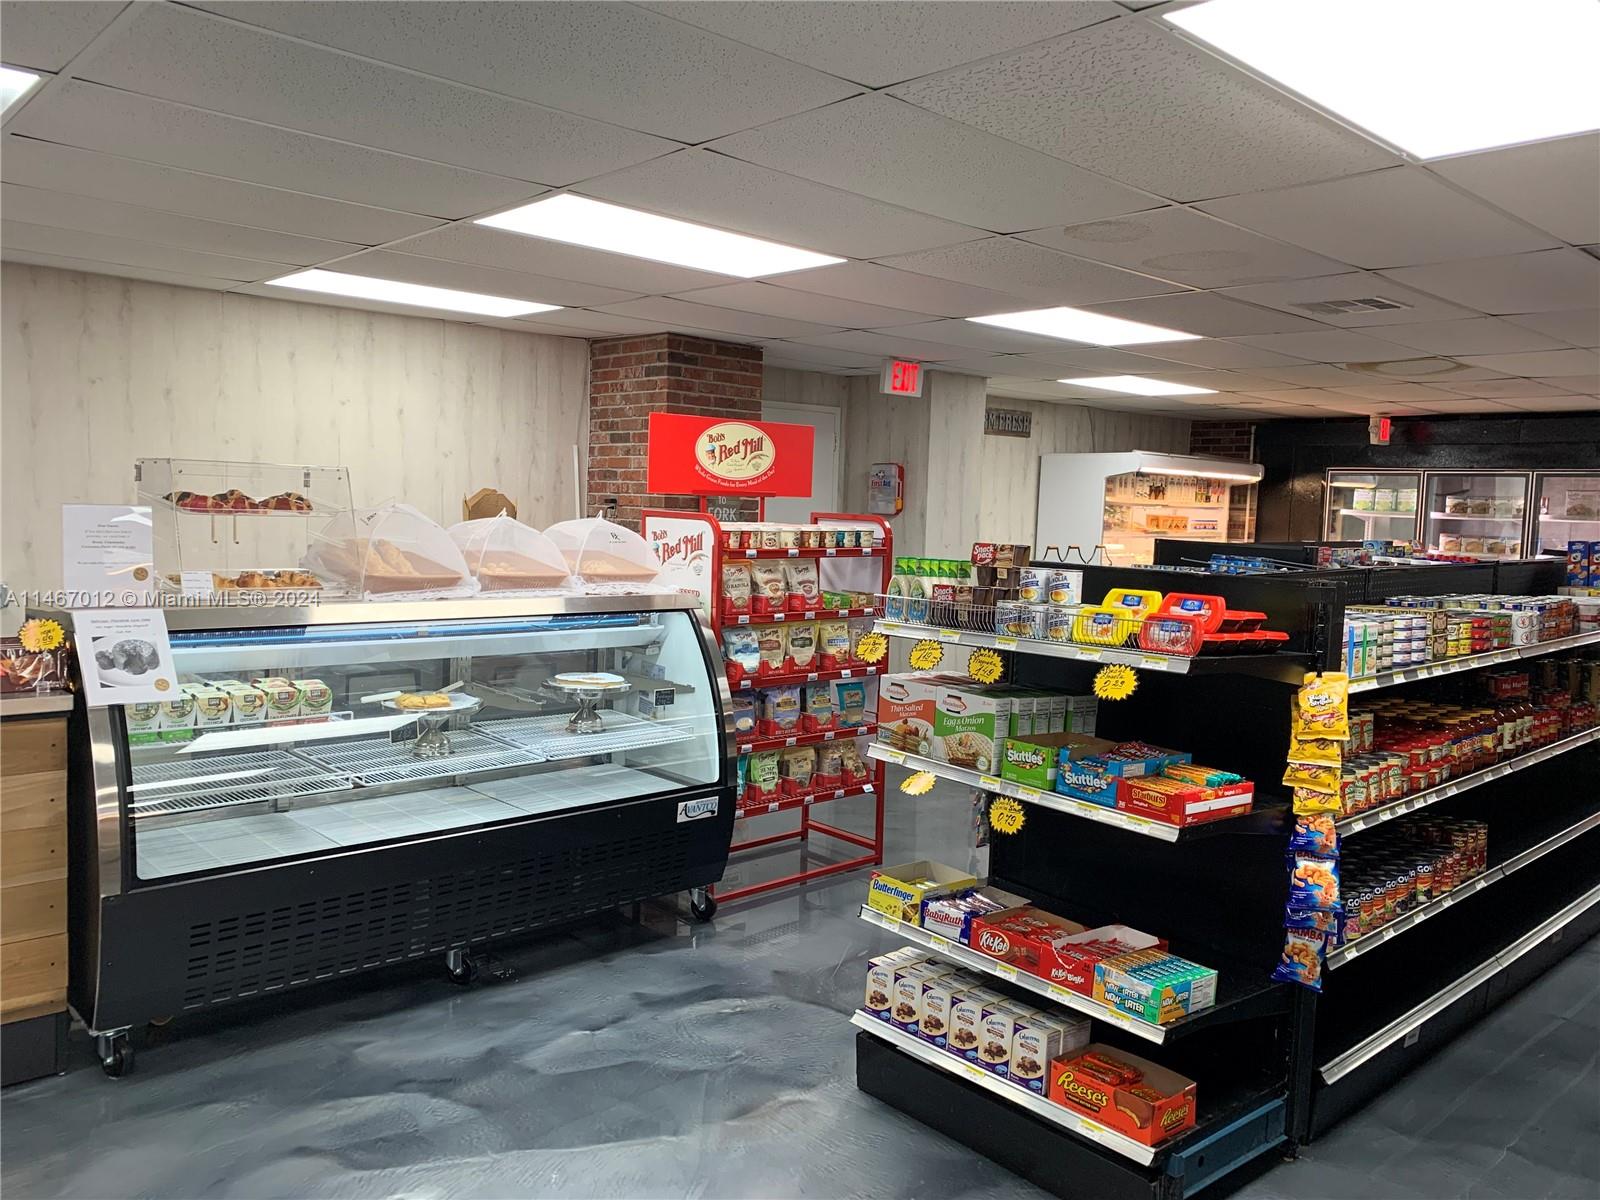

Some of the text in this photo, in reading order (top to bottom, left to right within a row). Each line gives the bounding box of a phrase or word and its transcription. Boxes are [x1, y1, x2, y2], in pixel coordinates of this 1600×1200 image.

[891, 360, 919, 393] EXIT
[999, 413, 1030, 432] FRESH
[707, 433, 725, 443] Bob's
[718, 435, 764, 466] Red Mill
[883, 479, 891, 487] Aid
[719, 496, 727, 504] TO
[708, 507, 737, 521] FORK
[662, 532, 703, 566] Red Mill
[973, 544, 995, 555] Snack
[976, 552, 993, 563] pack
[891, 703, 924, 713] Thin Salted
[943, 717, 956, 727] Egg
[962, 715, 985, 726] Onion
[955, 724, 977, 733] Matzos
[1007, 749, 1043, 765] Skittles
[1064, 771, 1107, 790] Skittles
[1132, 788, 1166, 803] Starburst
[679, 802, 717, 818] AVANTCO
[872, 878, 915, 902] Butterfinger
[1105, 992, 1145, 1013] NOW LATER
